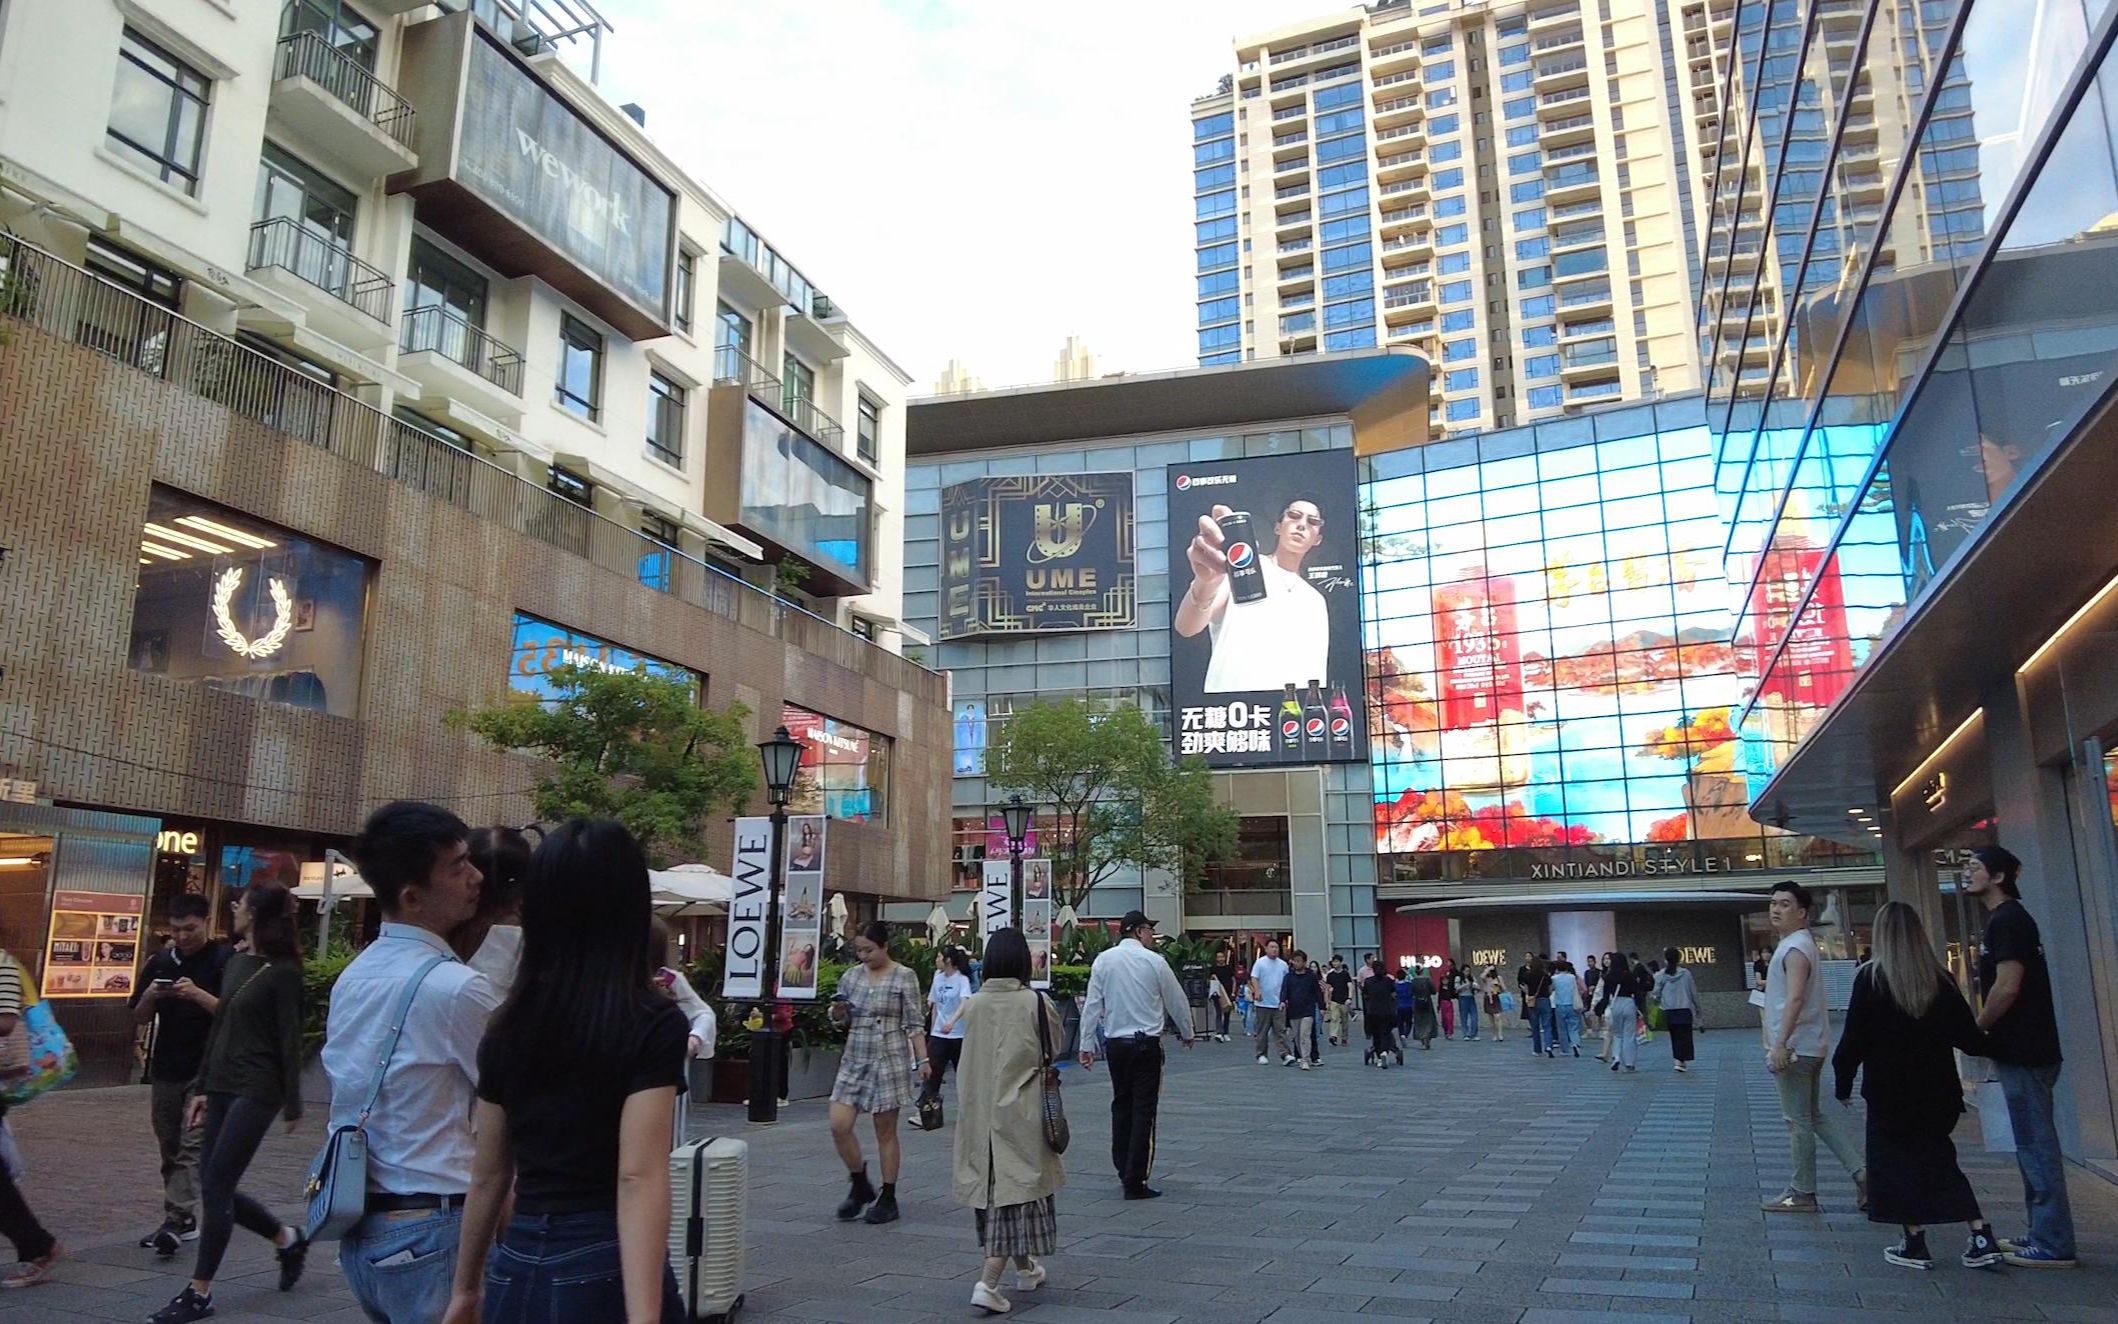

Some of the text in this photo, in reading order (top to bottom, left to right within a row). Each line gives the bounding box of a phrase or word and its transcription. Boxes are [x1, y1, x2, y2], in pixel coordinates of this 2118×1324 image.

[1026, 567, 1097, 590] UME
[1181, 701, 1271, 731] 无糖0卡
[1181, 729, 1271, 755] 劲爽够味
[1531, 861, 1635, 879] XINTIANDI
[1644, 857, 1718, 875] STYLE
[729, 834, 768, 980] LOEWE
